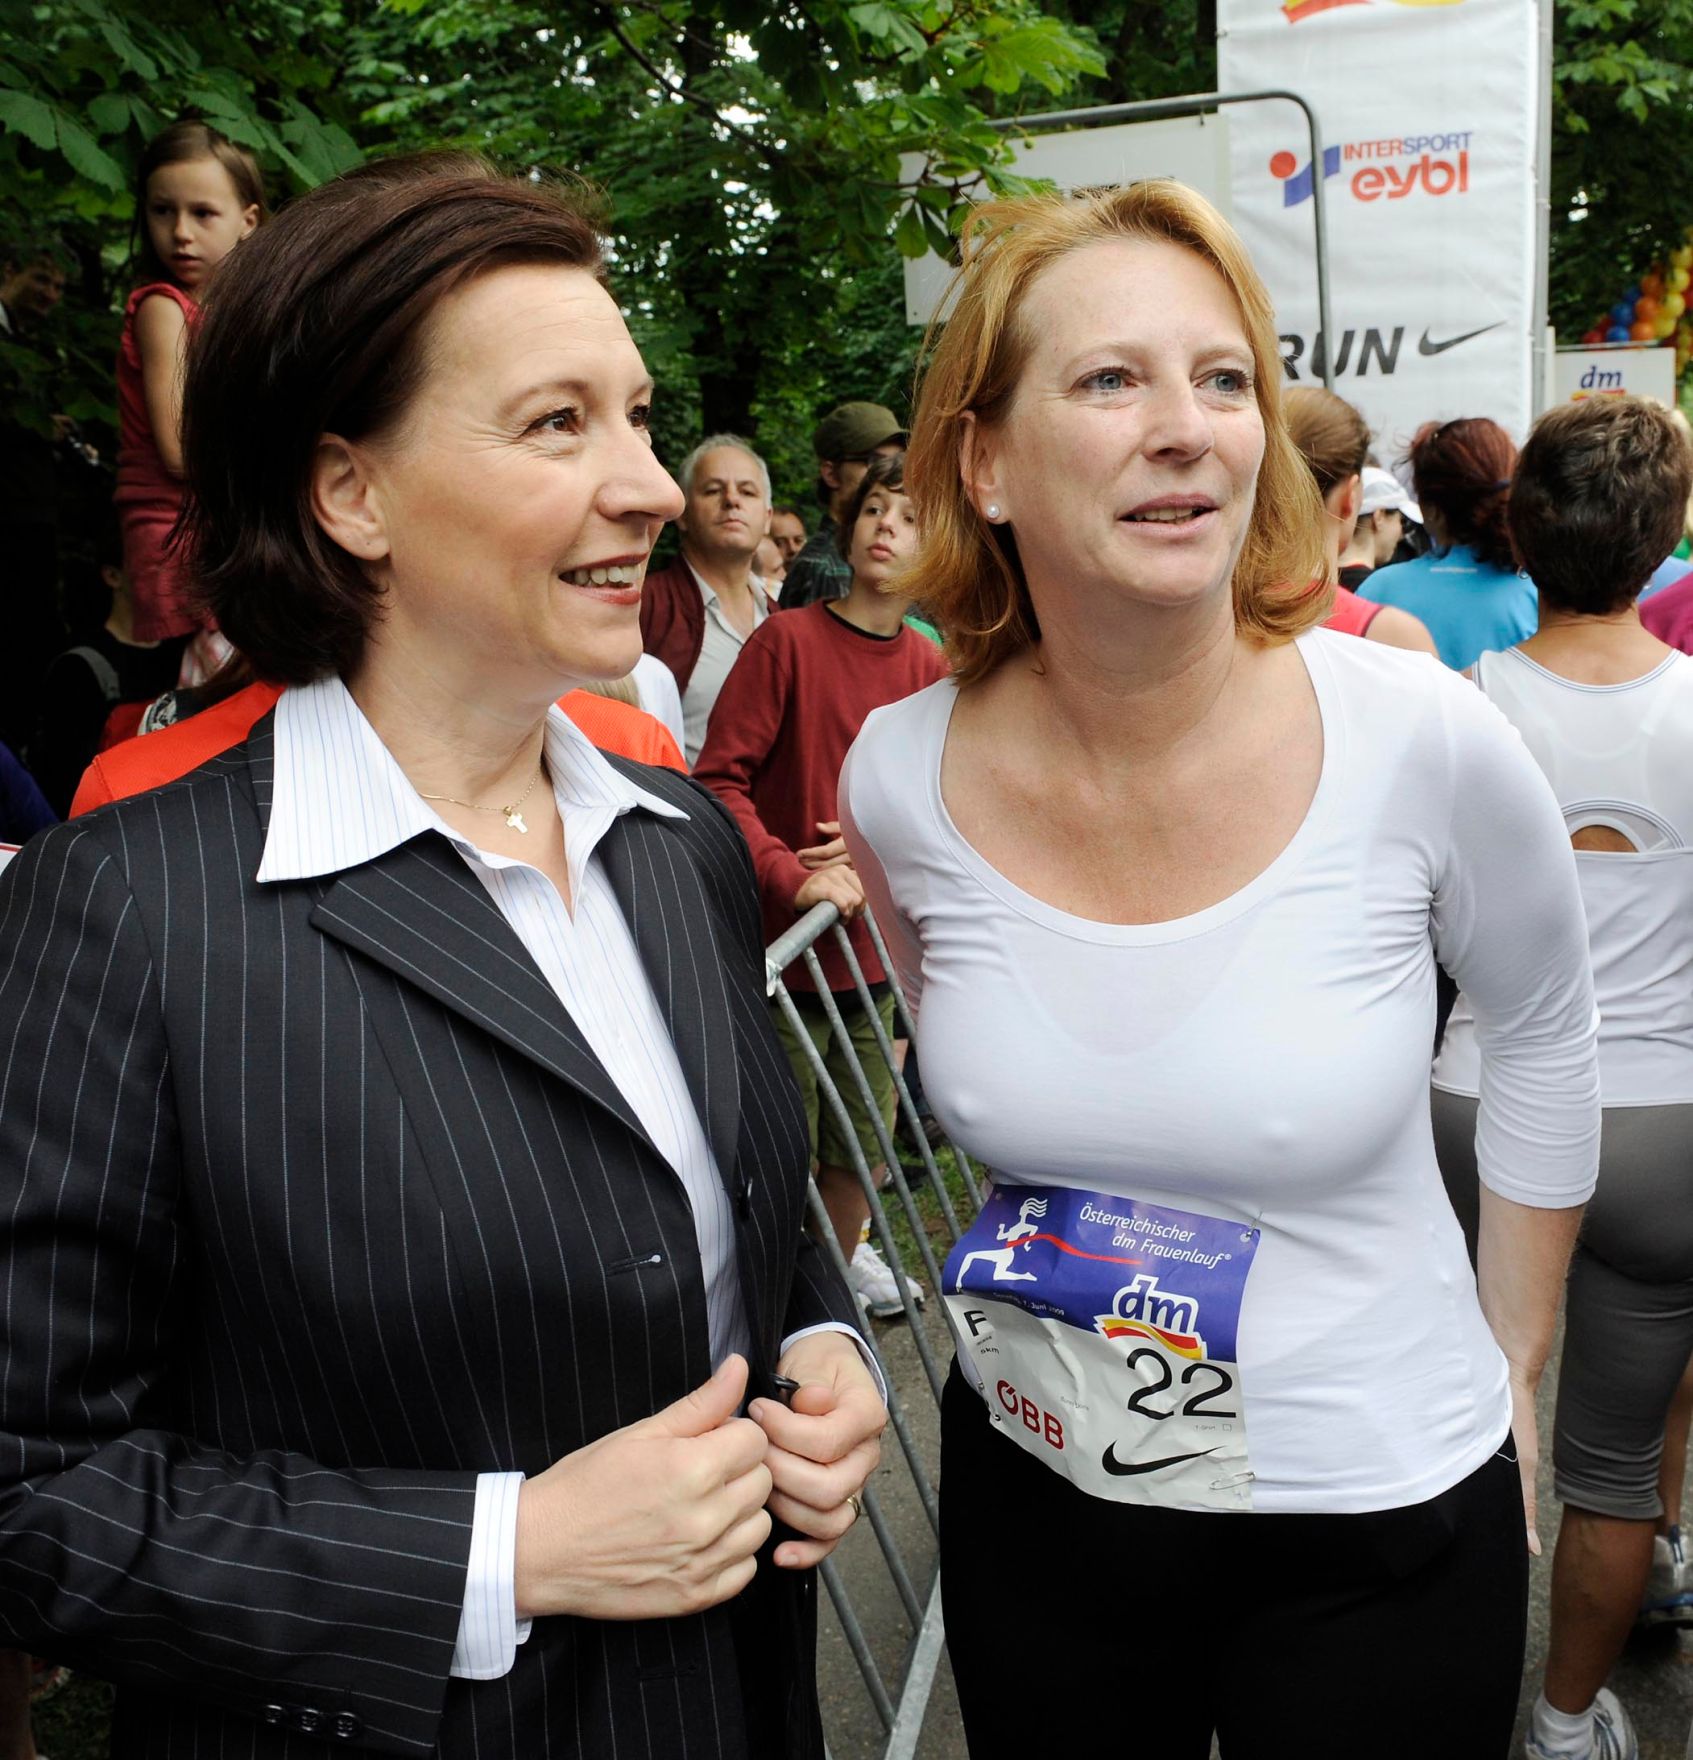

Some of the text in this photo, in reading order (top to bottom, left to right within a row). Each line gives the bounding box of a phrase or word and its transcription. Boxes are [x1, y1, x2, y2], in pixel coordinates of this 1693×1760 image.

[1344, 131, 1473, 161] INTERSPORT
[1350, 150, 1468, 203] eybl
[1278, 326, 1405, 380] RUN
[1580, 364, 1623, 389] dm
[1079, 1201, 1196, 1243] Österreichischer
[1112, 1232, 1137, 1250] dm
[963, 1310, 988, 1337] F
[1117, 1279, 1194, 1334] dm
[1126, 1347, 1237, 1420] 22
[996, 1379, 1064, 1450] ÖBB
